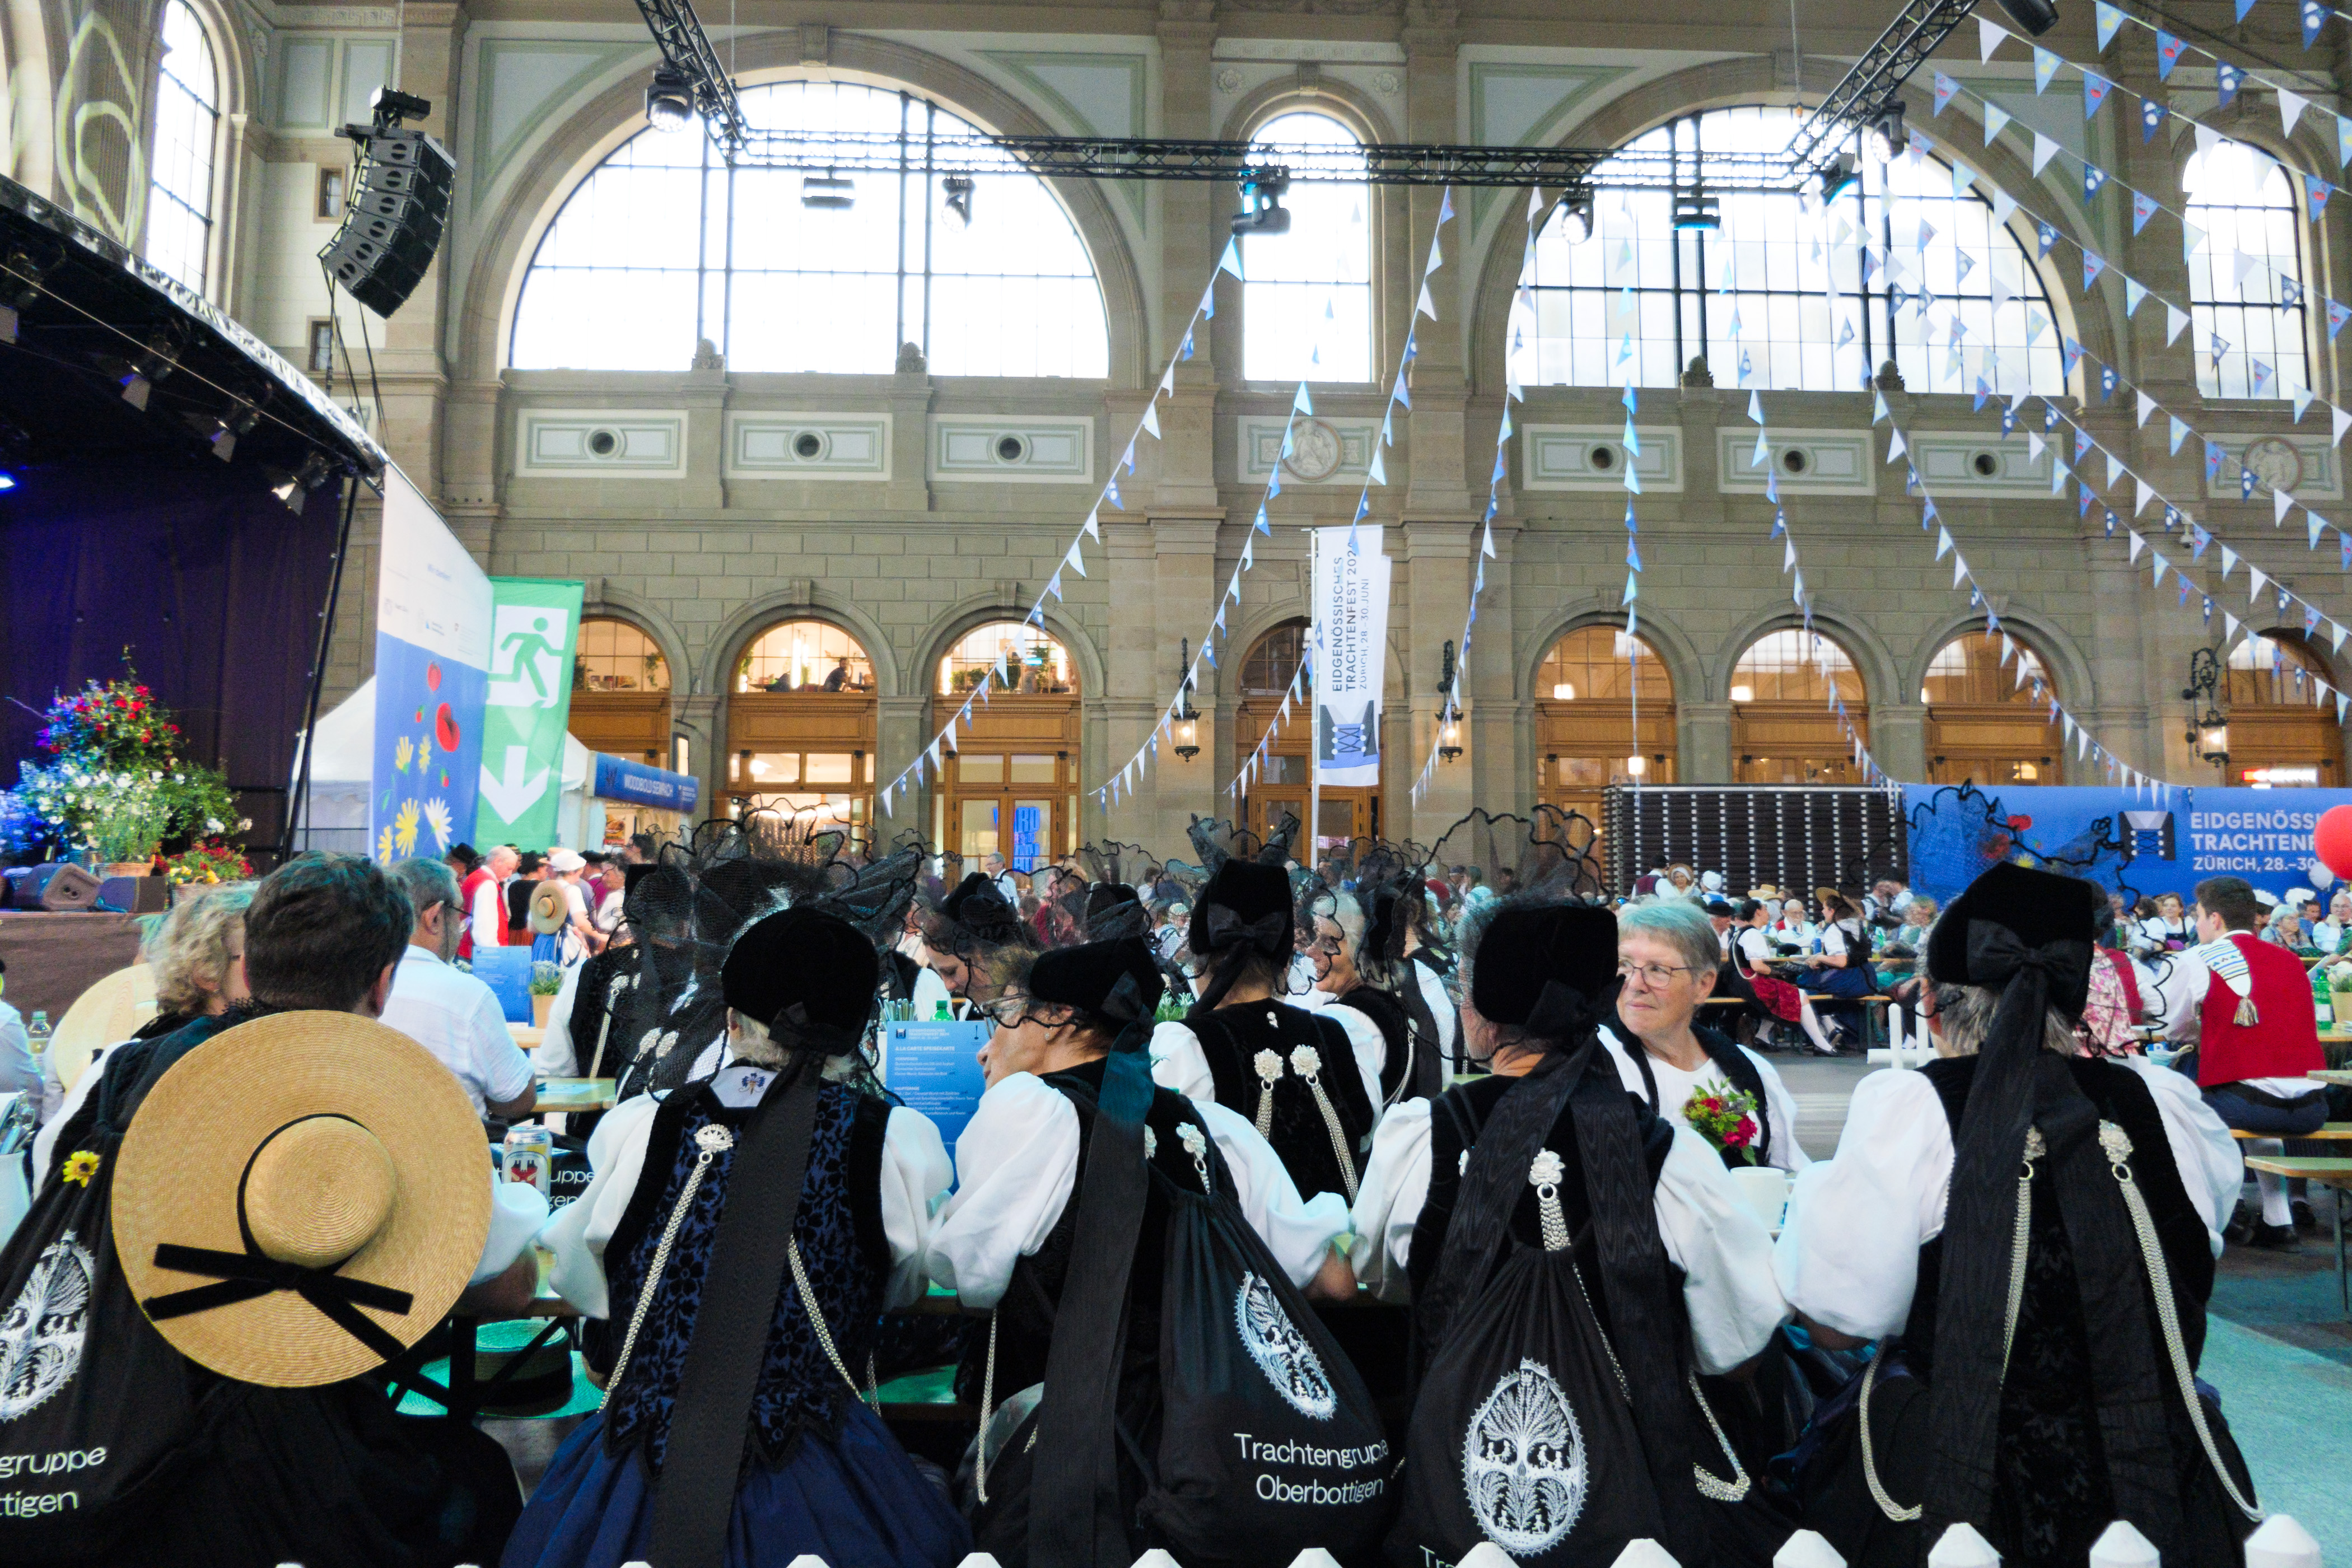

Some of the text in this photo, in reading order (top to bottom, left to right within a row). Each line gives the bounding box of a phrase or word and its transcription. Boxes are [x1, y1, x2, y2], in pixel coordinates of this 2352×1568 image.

[1346, 581, 1356, 692] TRACHTENFEST
[1359, 646, 1369, 689] ZÜRICH,
[2194, 856, 2262, 872] ZÜRICH,
[1234, 1433, 1389, 1468] Trachtengrupe
[1257, 1474, 1384, 1504] Oberbottigen
